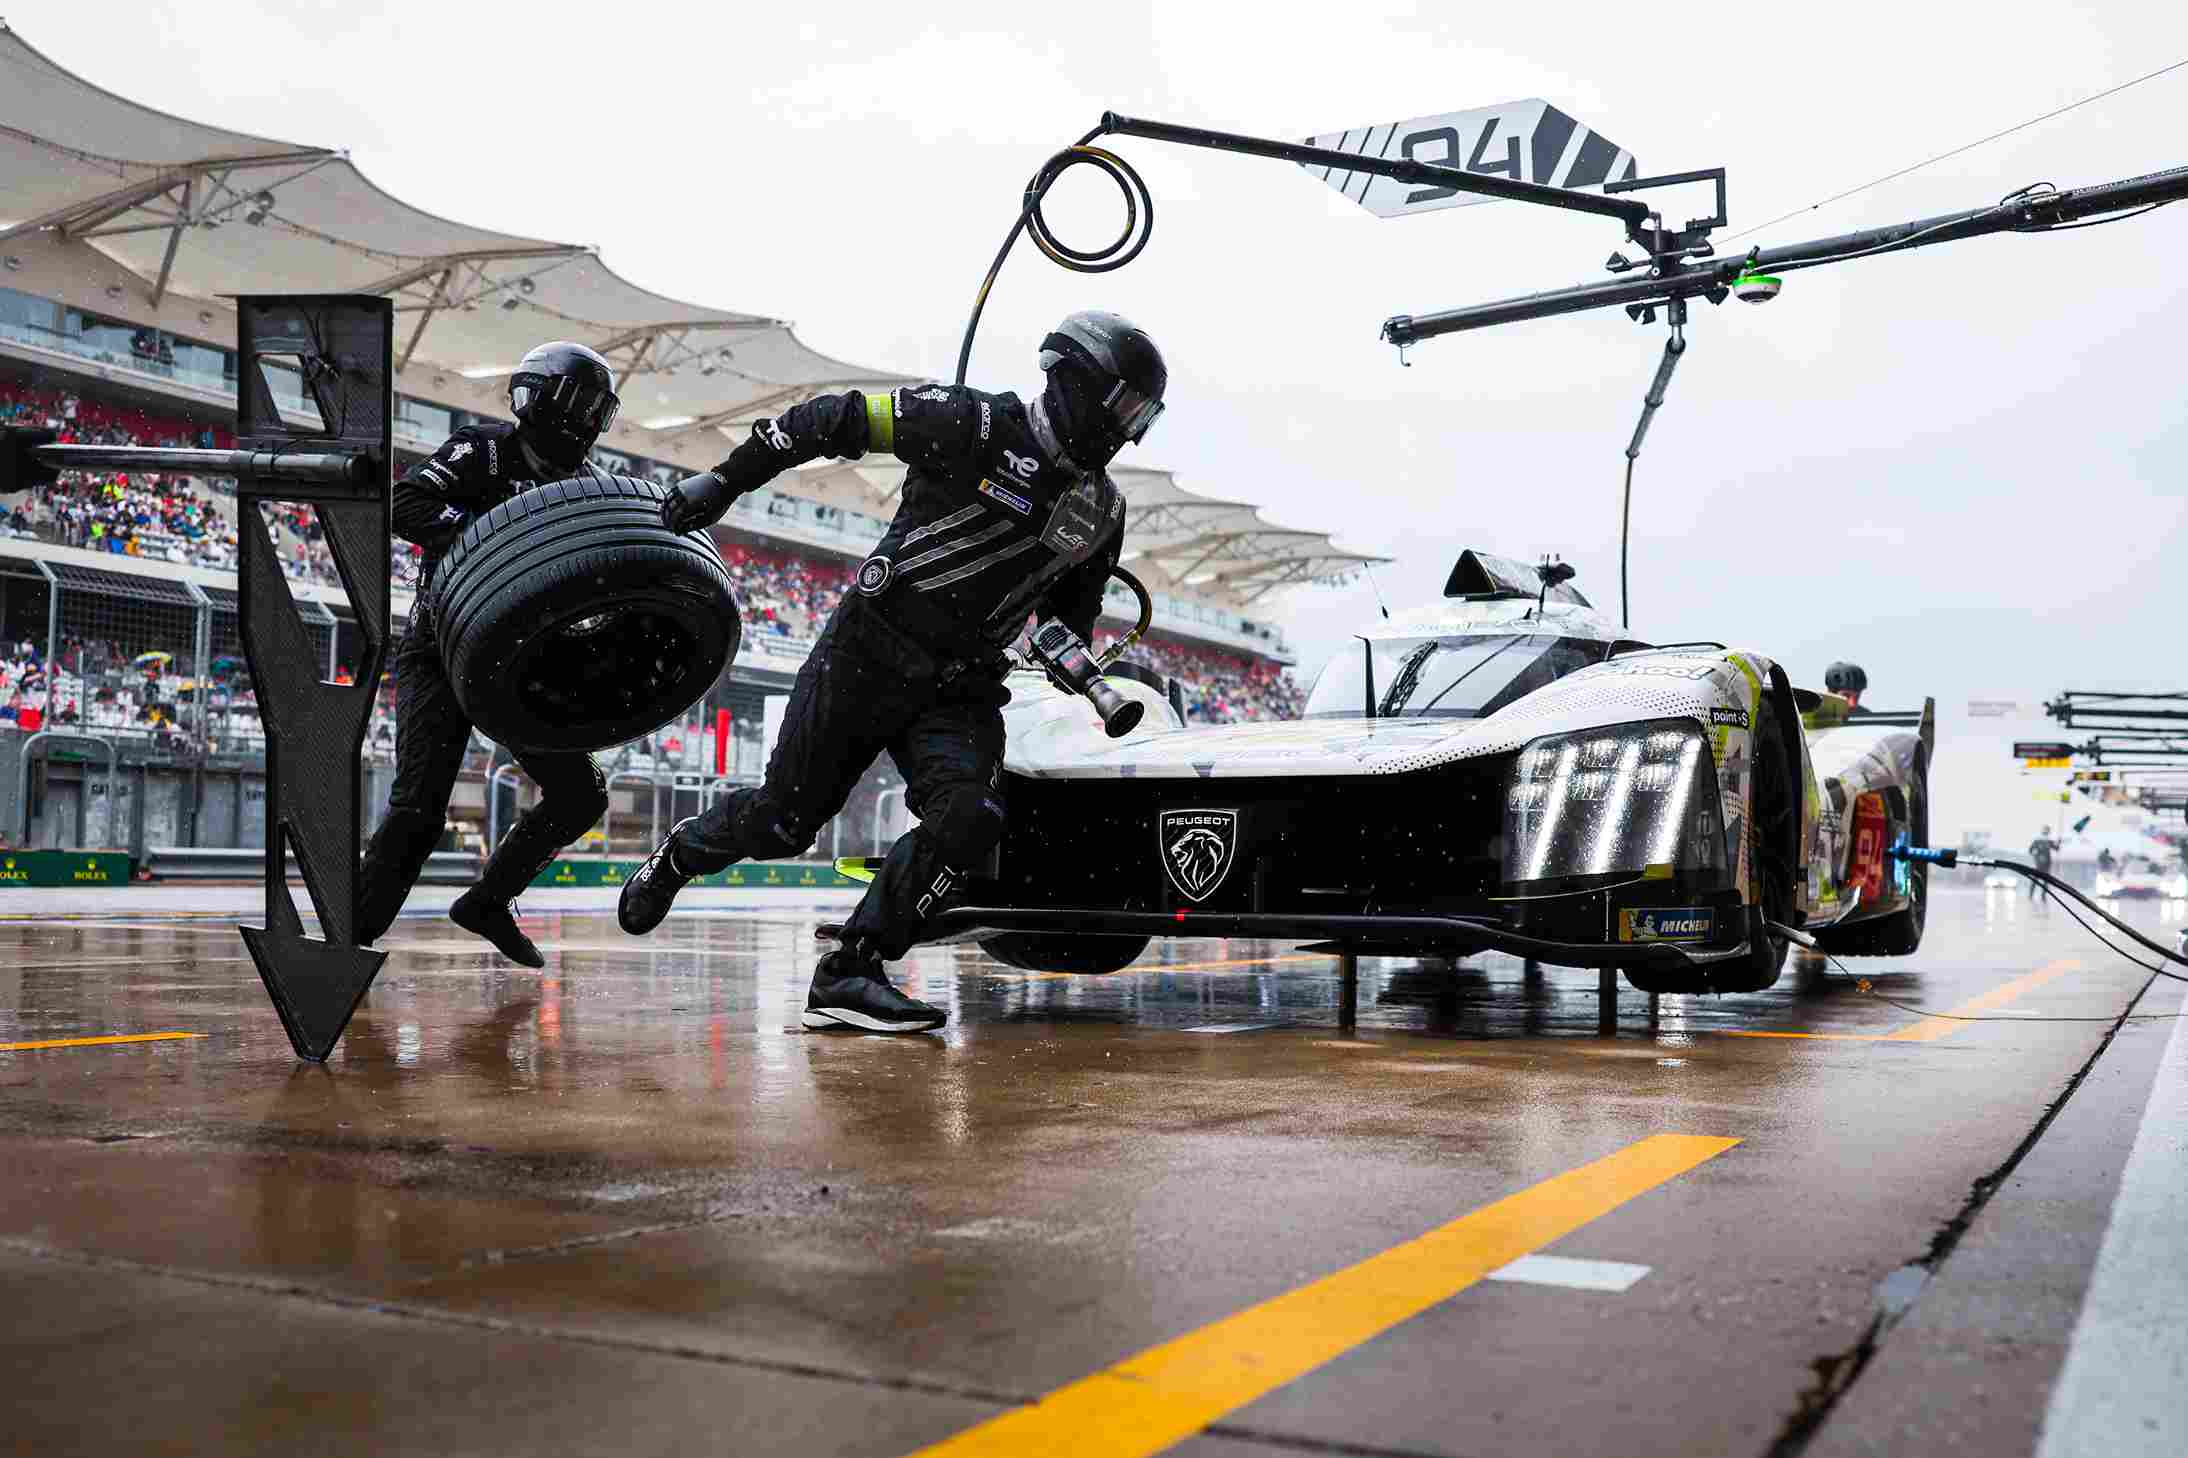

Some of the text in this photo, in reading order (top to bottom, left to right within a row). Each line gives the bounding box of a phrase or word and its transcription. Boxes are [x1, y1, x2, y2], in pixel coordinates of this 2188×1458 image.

[1401, 117, 1522, 204] 94
[1167, 816, 1231, 827] PEUGEOT
[0, 871, 28, 880] OLEX
